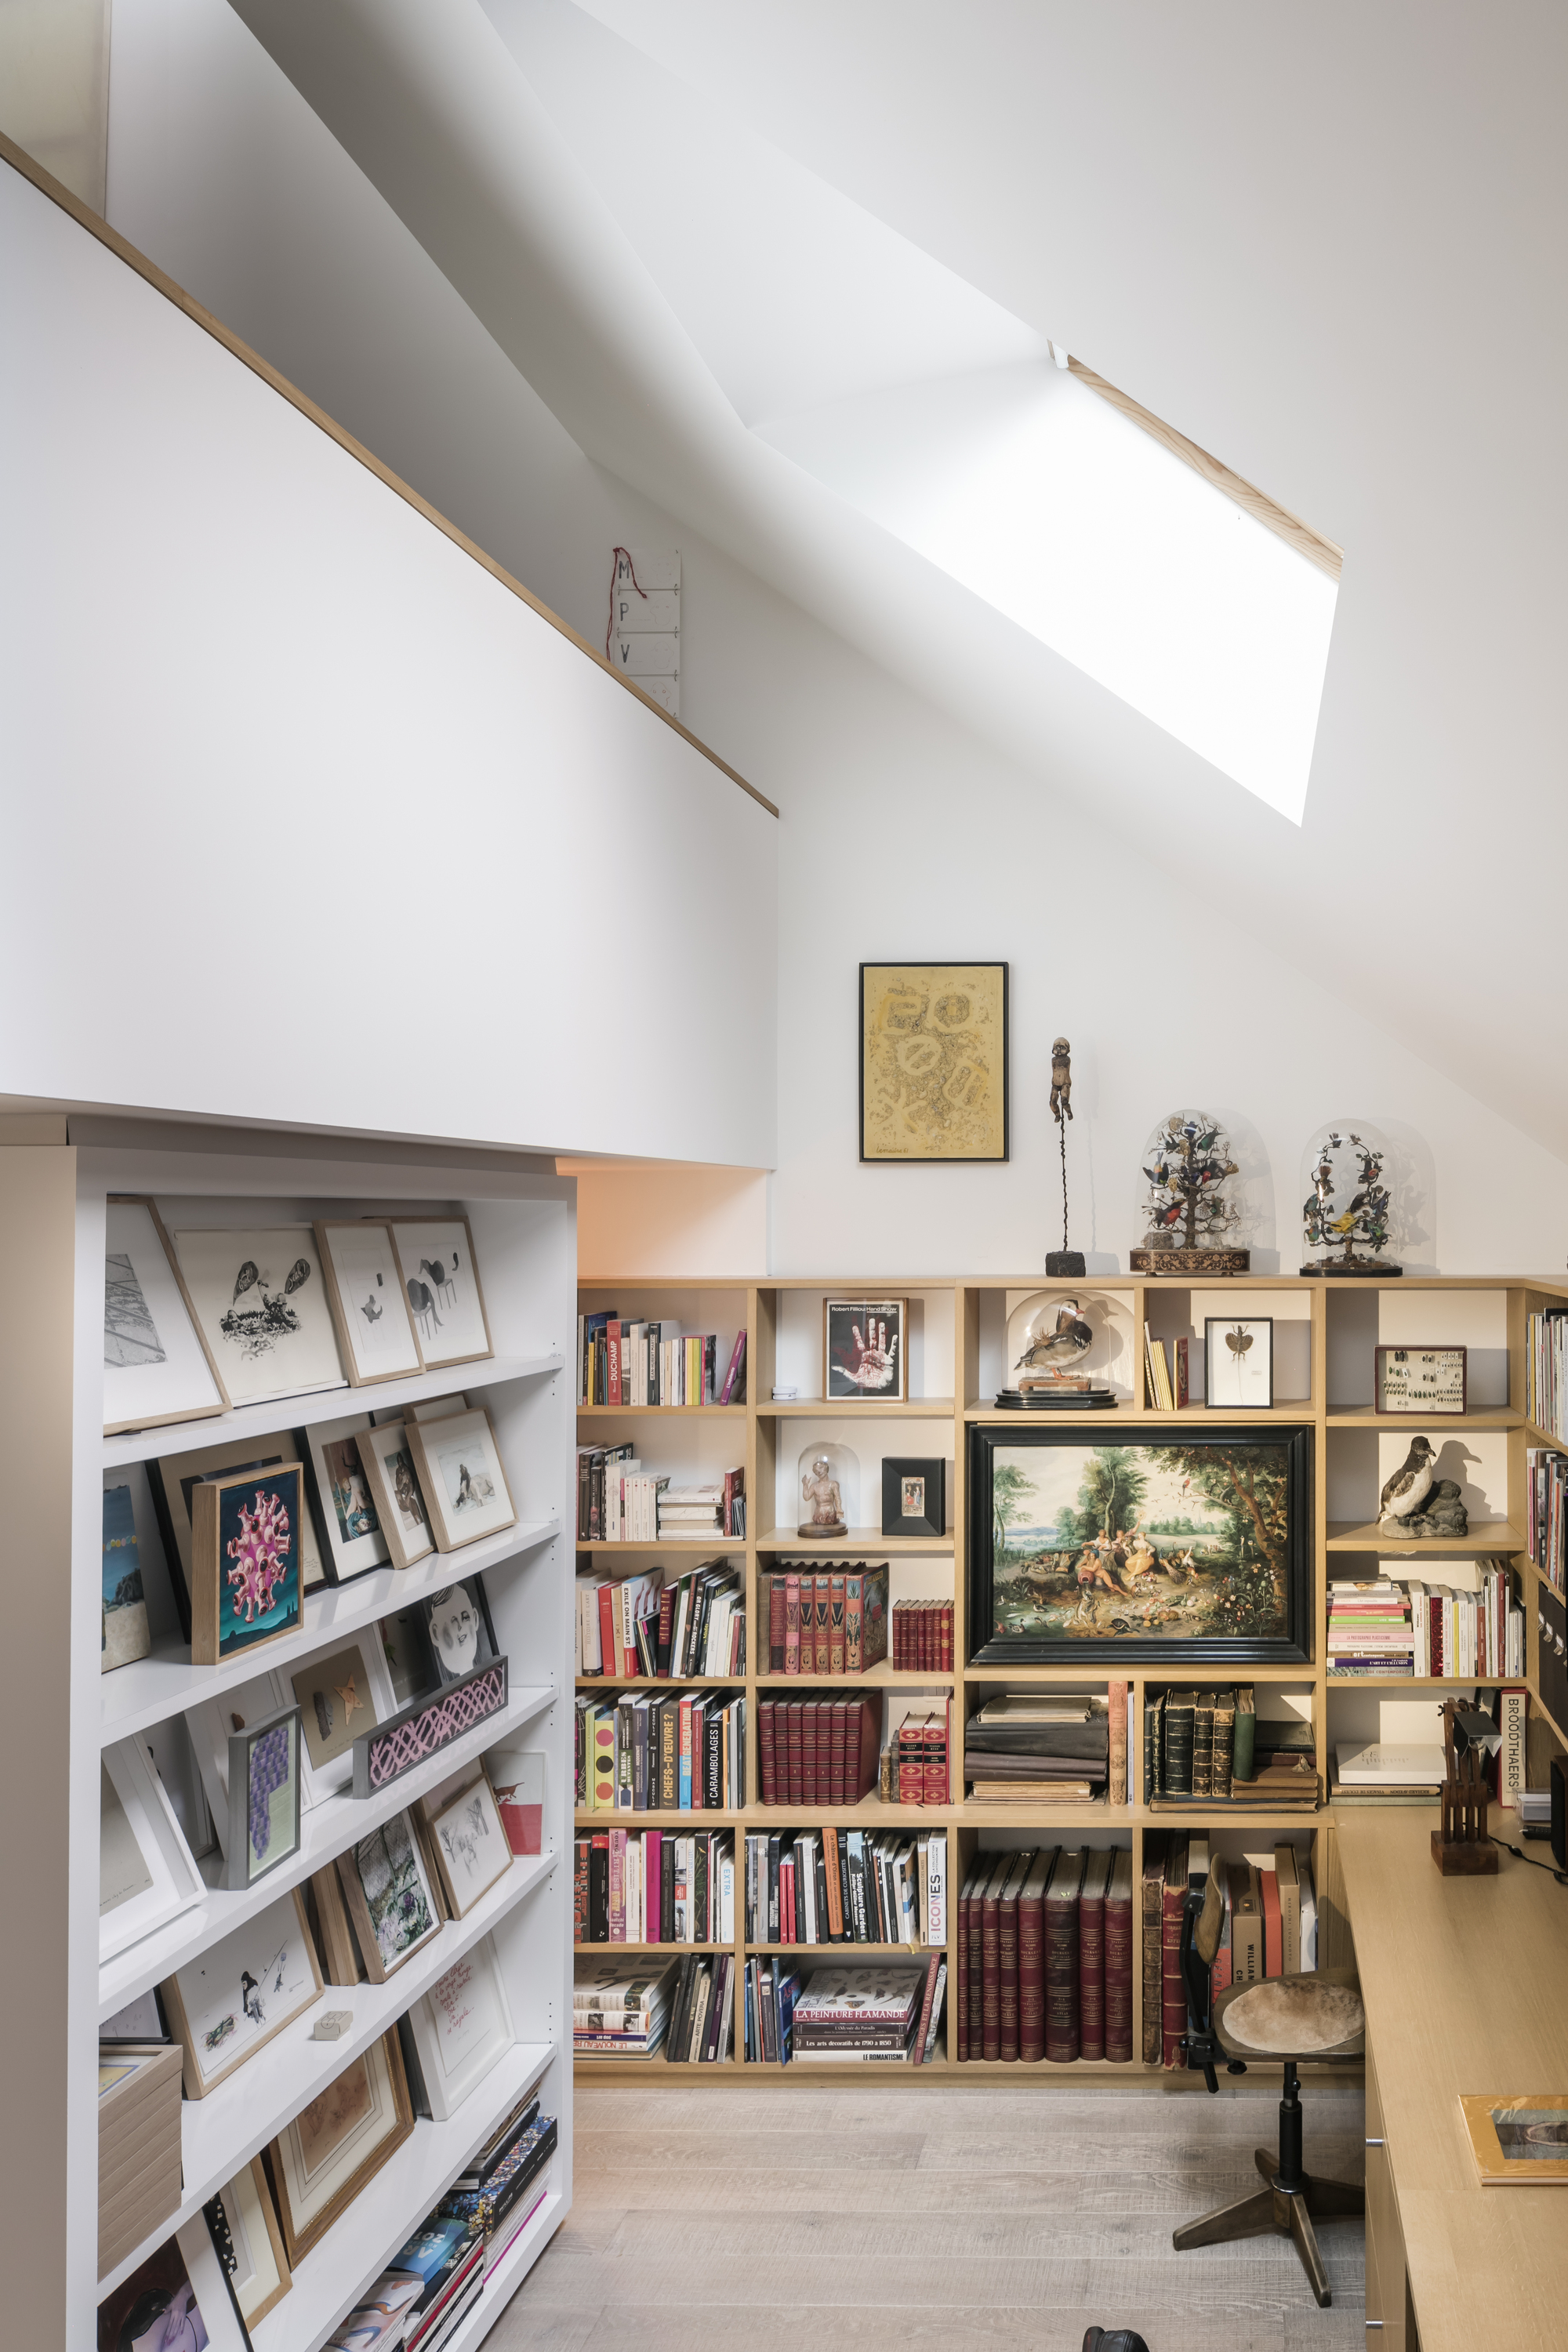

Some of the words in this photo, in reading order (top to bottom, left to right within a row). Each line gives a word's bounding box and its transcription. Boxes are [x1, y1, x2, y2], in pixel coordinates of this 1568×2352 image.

[619, 560, 630, 579] M
[619, 603, 630, 622] P
[620, 644, 630, 663] V
[726, 1367, 735, 1388] L'indolente
[625, 1607, 630, 1617] ON
[1508, 1698, 1519, 1788] BROODTHAERS
[663, 1721, 673, 1798] CHEFS-D'ŒUVRE
[710, 1730, 718, 1798] CARAMBOLAGES
[612, 1849, 622, 1889] BRITISH
[930, 1875, 941, 1932] ICONES
[925, 1957, 938, 2001] RENAISSANCE
[696, 2000, 705, 2022] POVERA
[923, 2003, 930, 2012] LA
[917, 2023, 927, 2048] BRUGES
[413, 2231, 445, 2244] 201
[398, 2245, 434, 2259] AR
